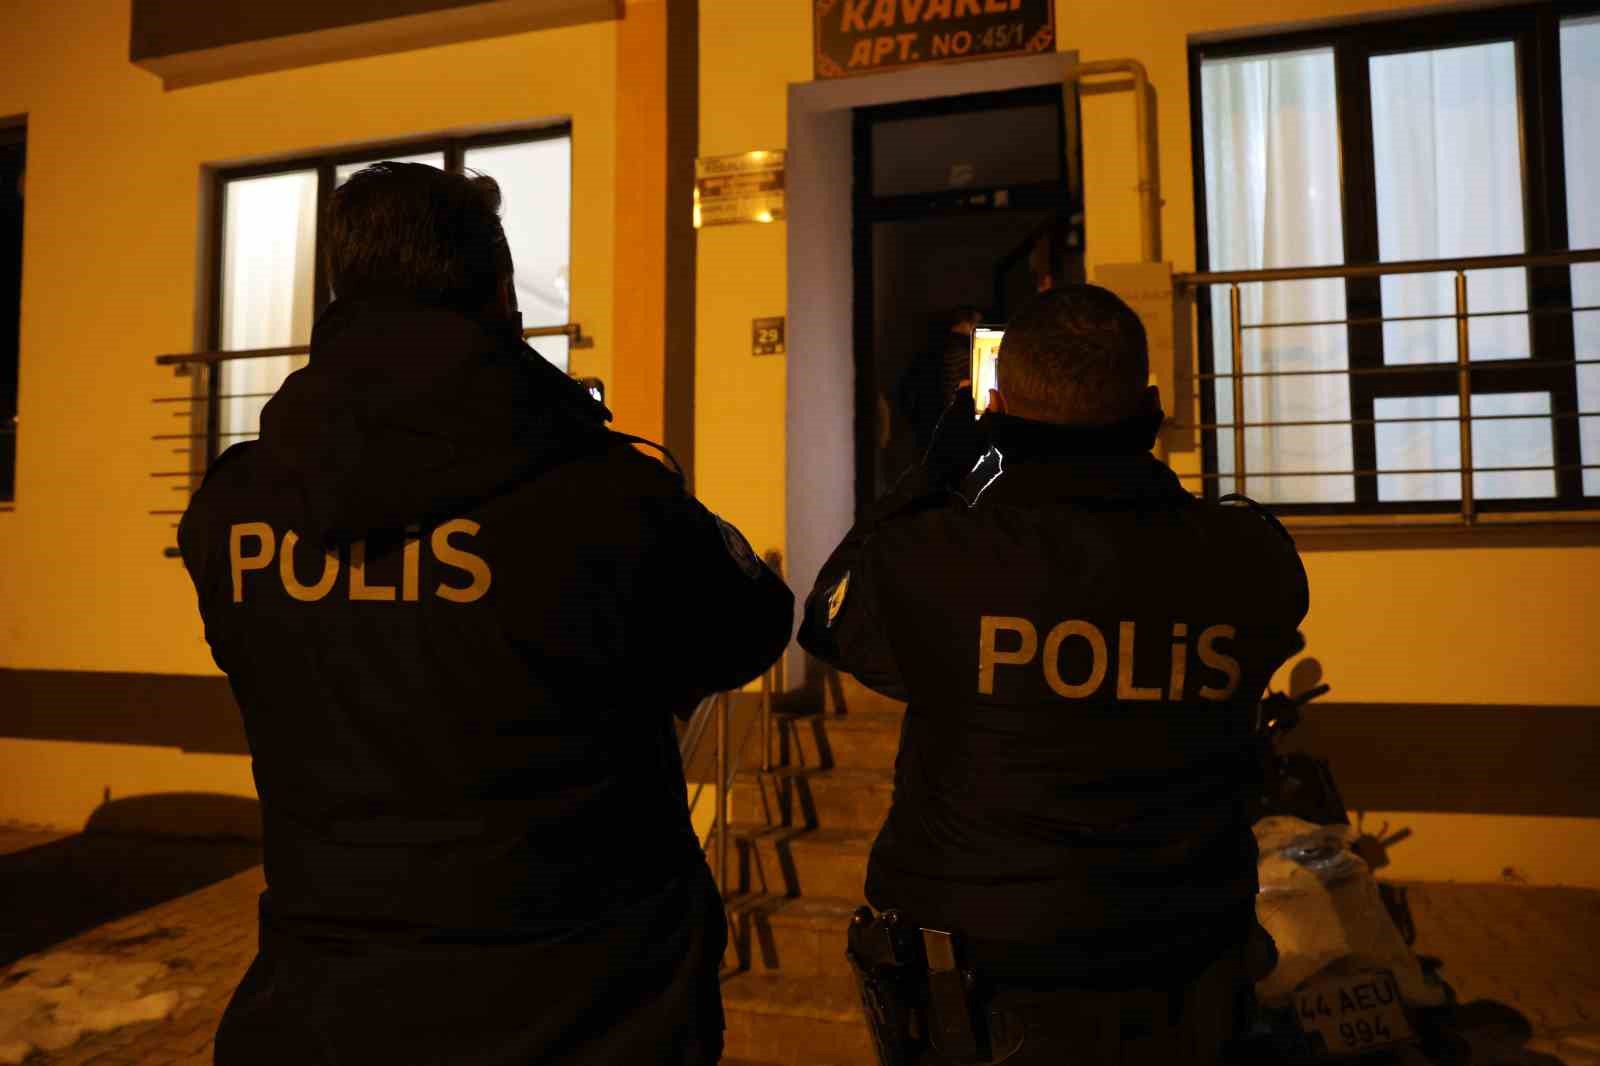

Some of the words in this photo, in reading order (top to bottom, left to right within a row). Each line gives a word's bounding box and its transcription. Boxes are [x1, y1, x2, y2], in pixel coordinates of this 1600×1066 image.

[840, 0, 1024, 33] KAVA
[848, 32, 920, 68] APT.
[758, 328, 778, 344] 29
[1300, 990, 1332, 1017] 44
[1338, 978, 1394, 1014] AEU
[1339, 1015, 1391, 1047] 994
